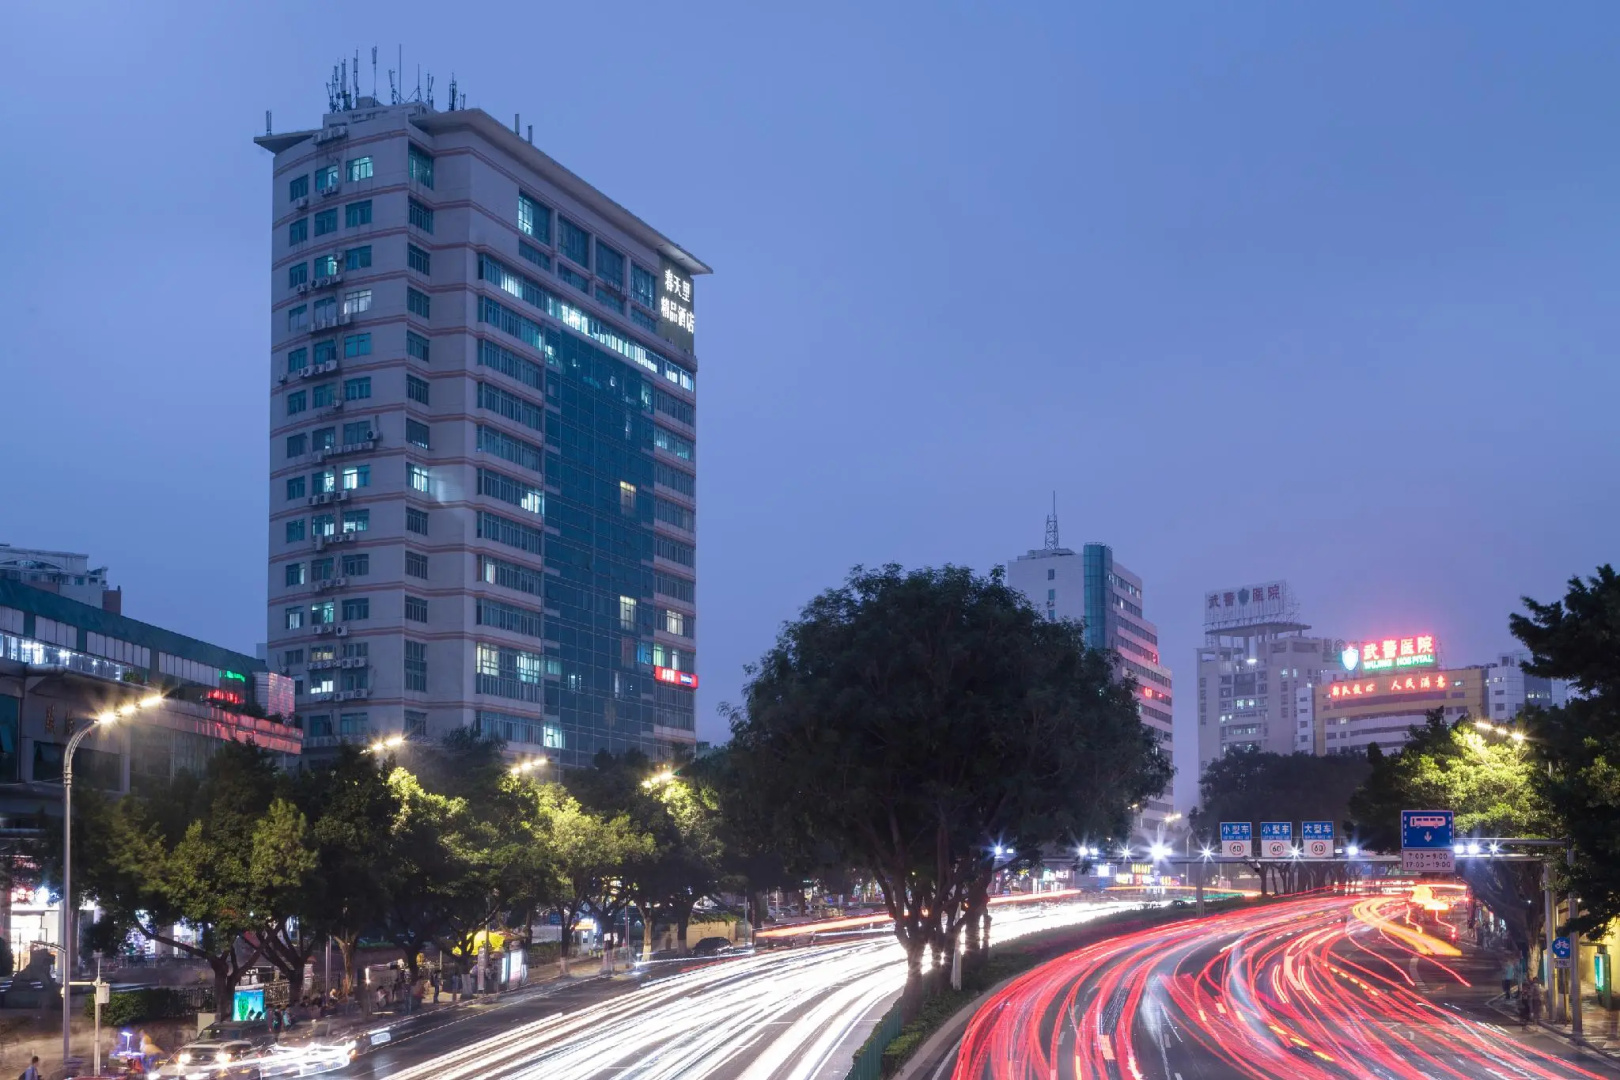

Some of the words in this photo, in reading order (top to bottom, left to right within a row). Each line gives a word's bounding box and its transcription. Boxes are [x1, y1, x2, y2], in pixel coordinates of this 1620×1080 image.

[664, 268, 691, 303] 春天里
[660, 295, 695, 334] 精品酒店
[1208, 583, 1281, 609] 武警医院
[1363, 635, 1434, 661] 武警医院
[1223, 825, 1250, 835] 小型车
[1262, 825, 1290, 835] 小型车
[1304, 824, 1332, 834] 大型车
